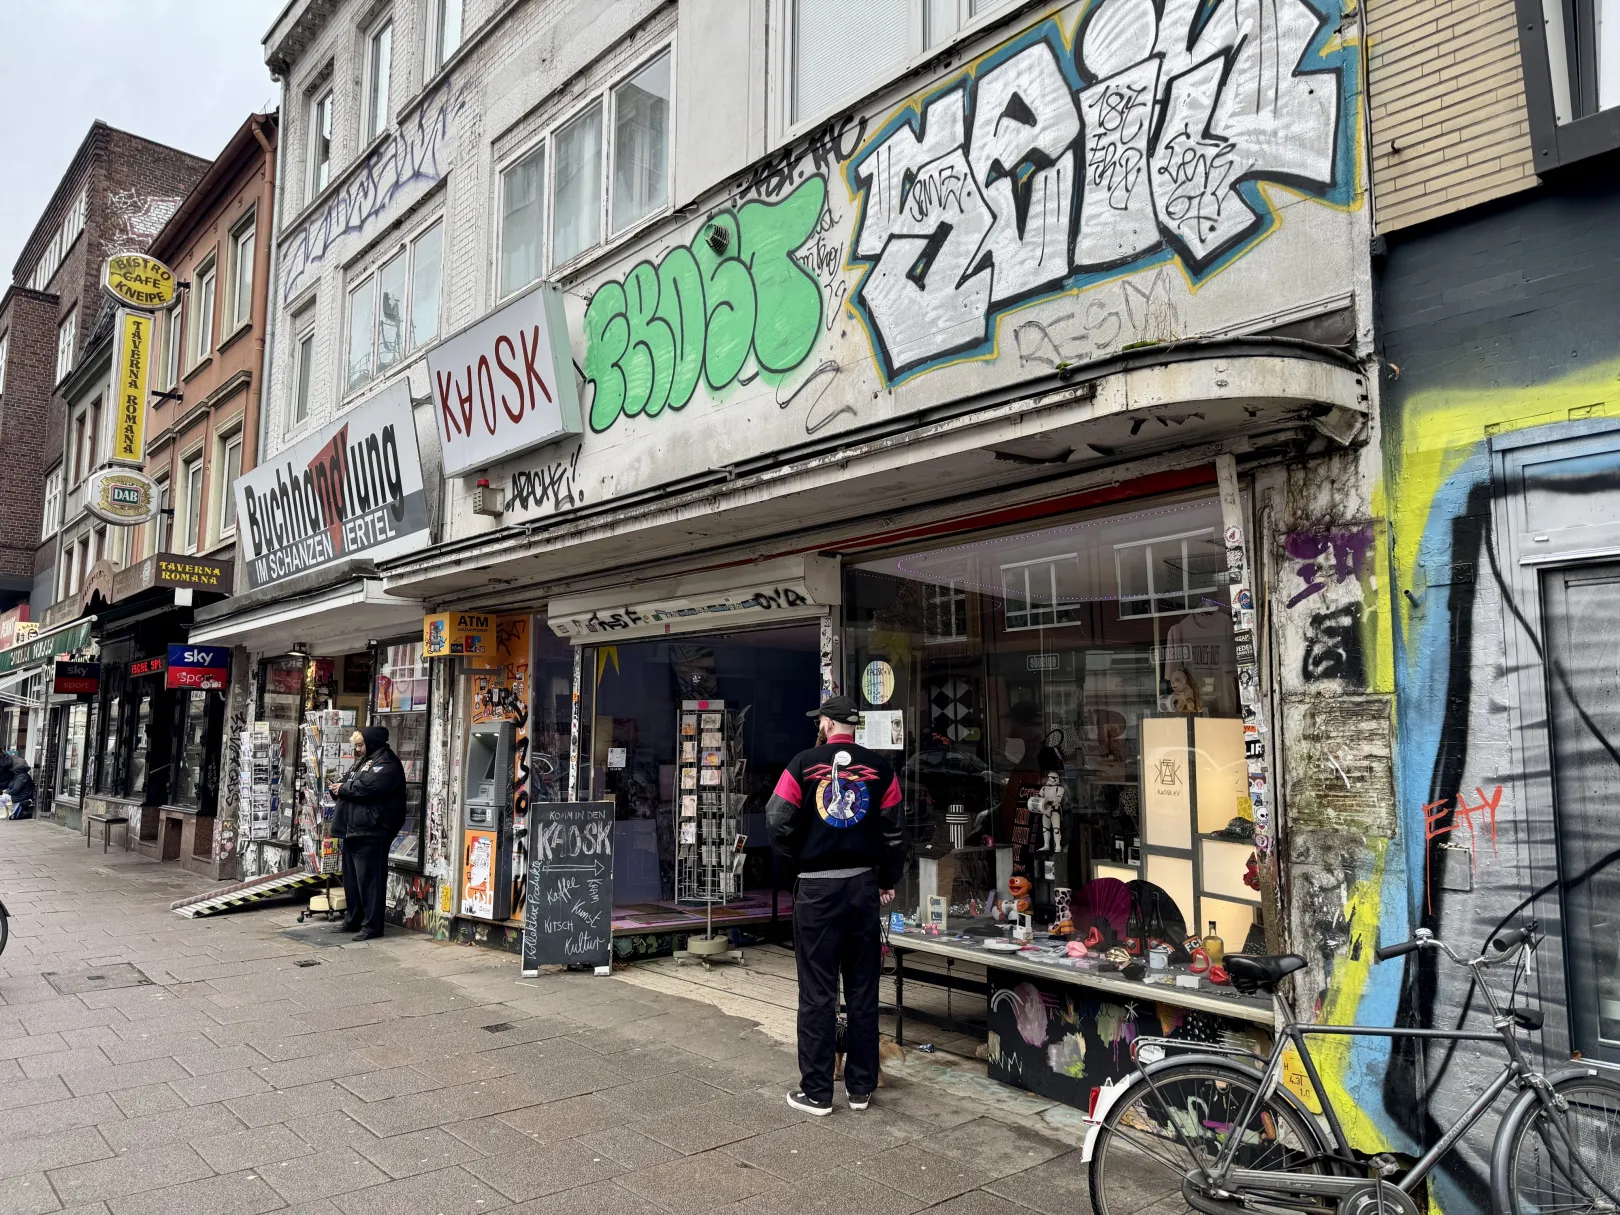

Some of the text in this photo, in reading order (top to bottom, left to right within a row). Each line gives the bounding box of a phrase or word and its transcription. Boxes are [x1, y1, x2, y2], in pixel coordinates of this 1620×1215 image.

[115, 257, 171, 281] BISTRO
[123, 271, 161, 289] CAFE
[115, 281, 166, 303] KNEIPE
[122, 320, 143, 455] TAVERNA ROMANA
[114, 489, 138, 501] DAB
[244, 423, 405, 558] Buchhandlung
[159, 561, 221, 576] TAVERNA
[255, 559, 269, 584] IM
[161, 571, 218, 585] ROMANA
[458, 615, 488, 627] ATM
[184, 649, 213, 665] sky
[67, 665, 88, 676] sky
[64, 681, 89, 690] sport
[549, 810, 606, 820] KOMM IN DEN
[537, 820, 612, 862] KAOSK
[546, 876, 581, 906] Kaffee
[571, 898, 603, 928] Kunst
[564, 930, 605, 956] Kultur
[1289, 1076, 1301, 1085] 4.3
[1300, 1089, 1310, 1097] 1.0
